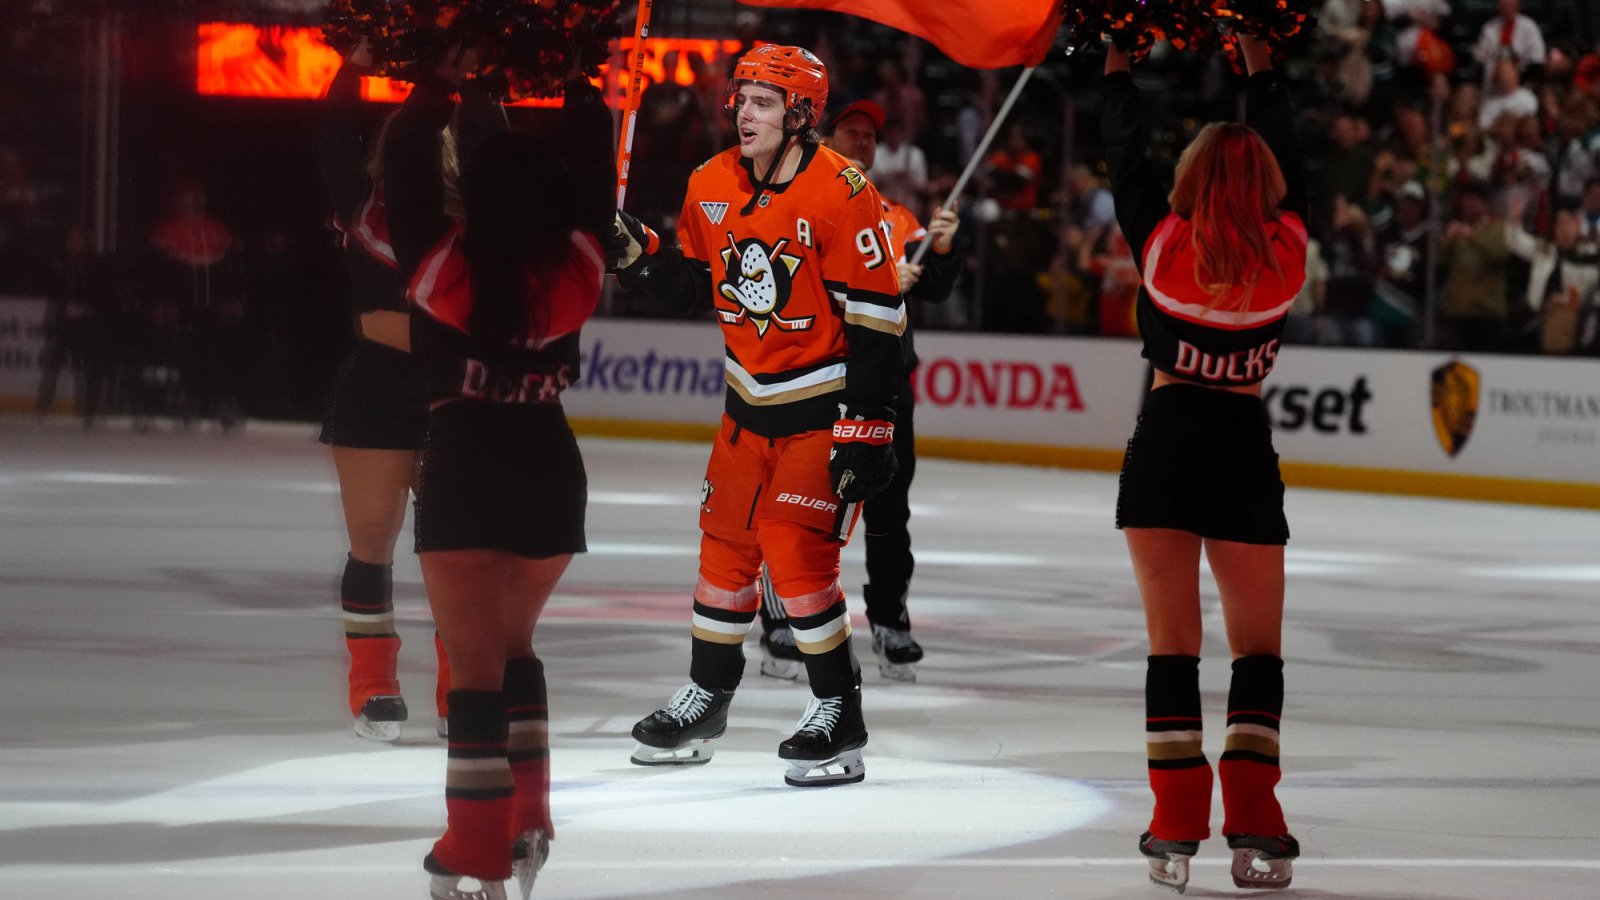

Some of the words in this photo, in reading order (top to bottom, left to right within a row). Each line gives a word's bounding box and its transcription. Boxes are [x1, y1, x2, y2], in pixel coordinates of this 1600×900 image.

[632, 53, 644, 93] DUCKS
[797, 218, 813, 249] A
[1175, 338, 1280, 382] DUCKS
[833, 424, 895, 440] BAUER
[775, 492, 838, 515] BAUER
